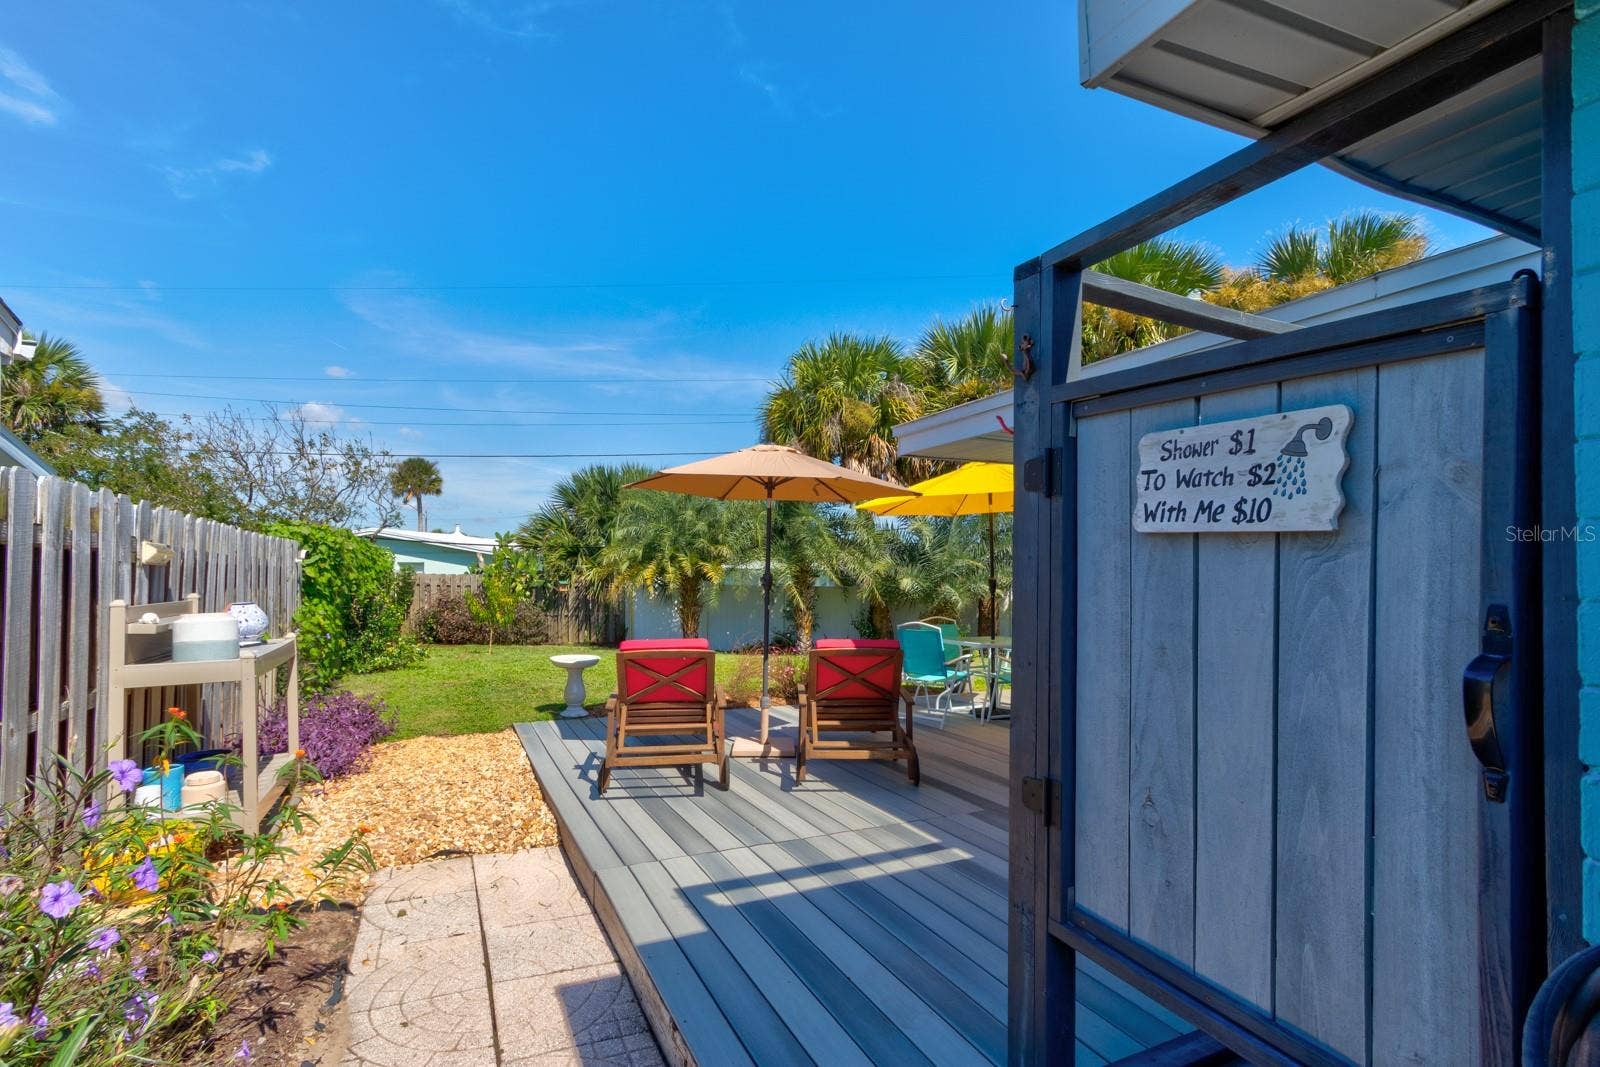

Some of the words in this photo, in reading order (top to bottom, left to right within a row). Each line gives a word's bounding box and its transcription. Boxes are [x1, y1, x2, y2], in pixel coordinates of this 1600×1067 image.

[1160, 439, 1219, 462] Shower
[1229, 428, 1256, 456] $1
[1141, 469, 1166, 491] To
[1176, 466, 1234, 489] Watch
[1247, 462, 1276, 487] $2
[1143, 500, 1187, 523] With
[1193, 499, 1225, 523] Me
[1232, 496, 1272, 525] $10
